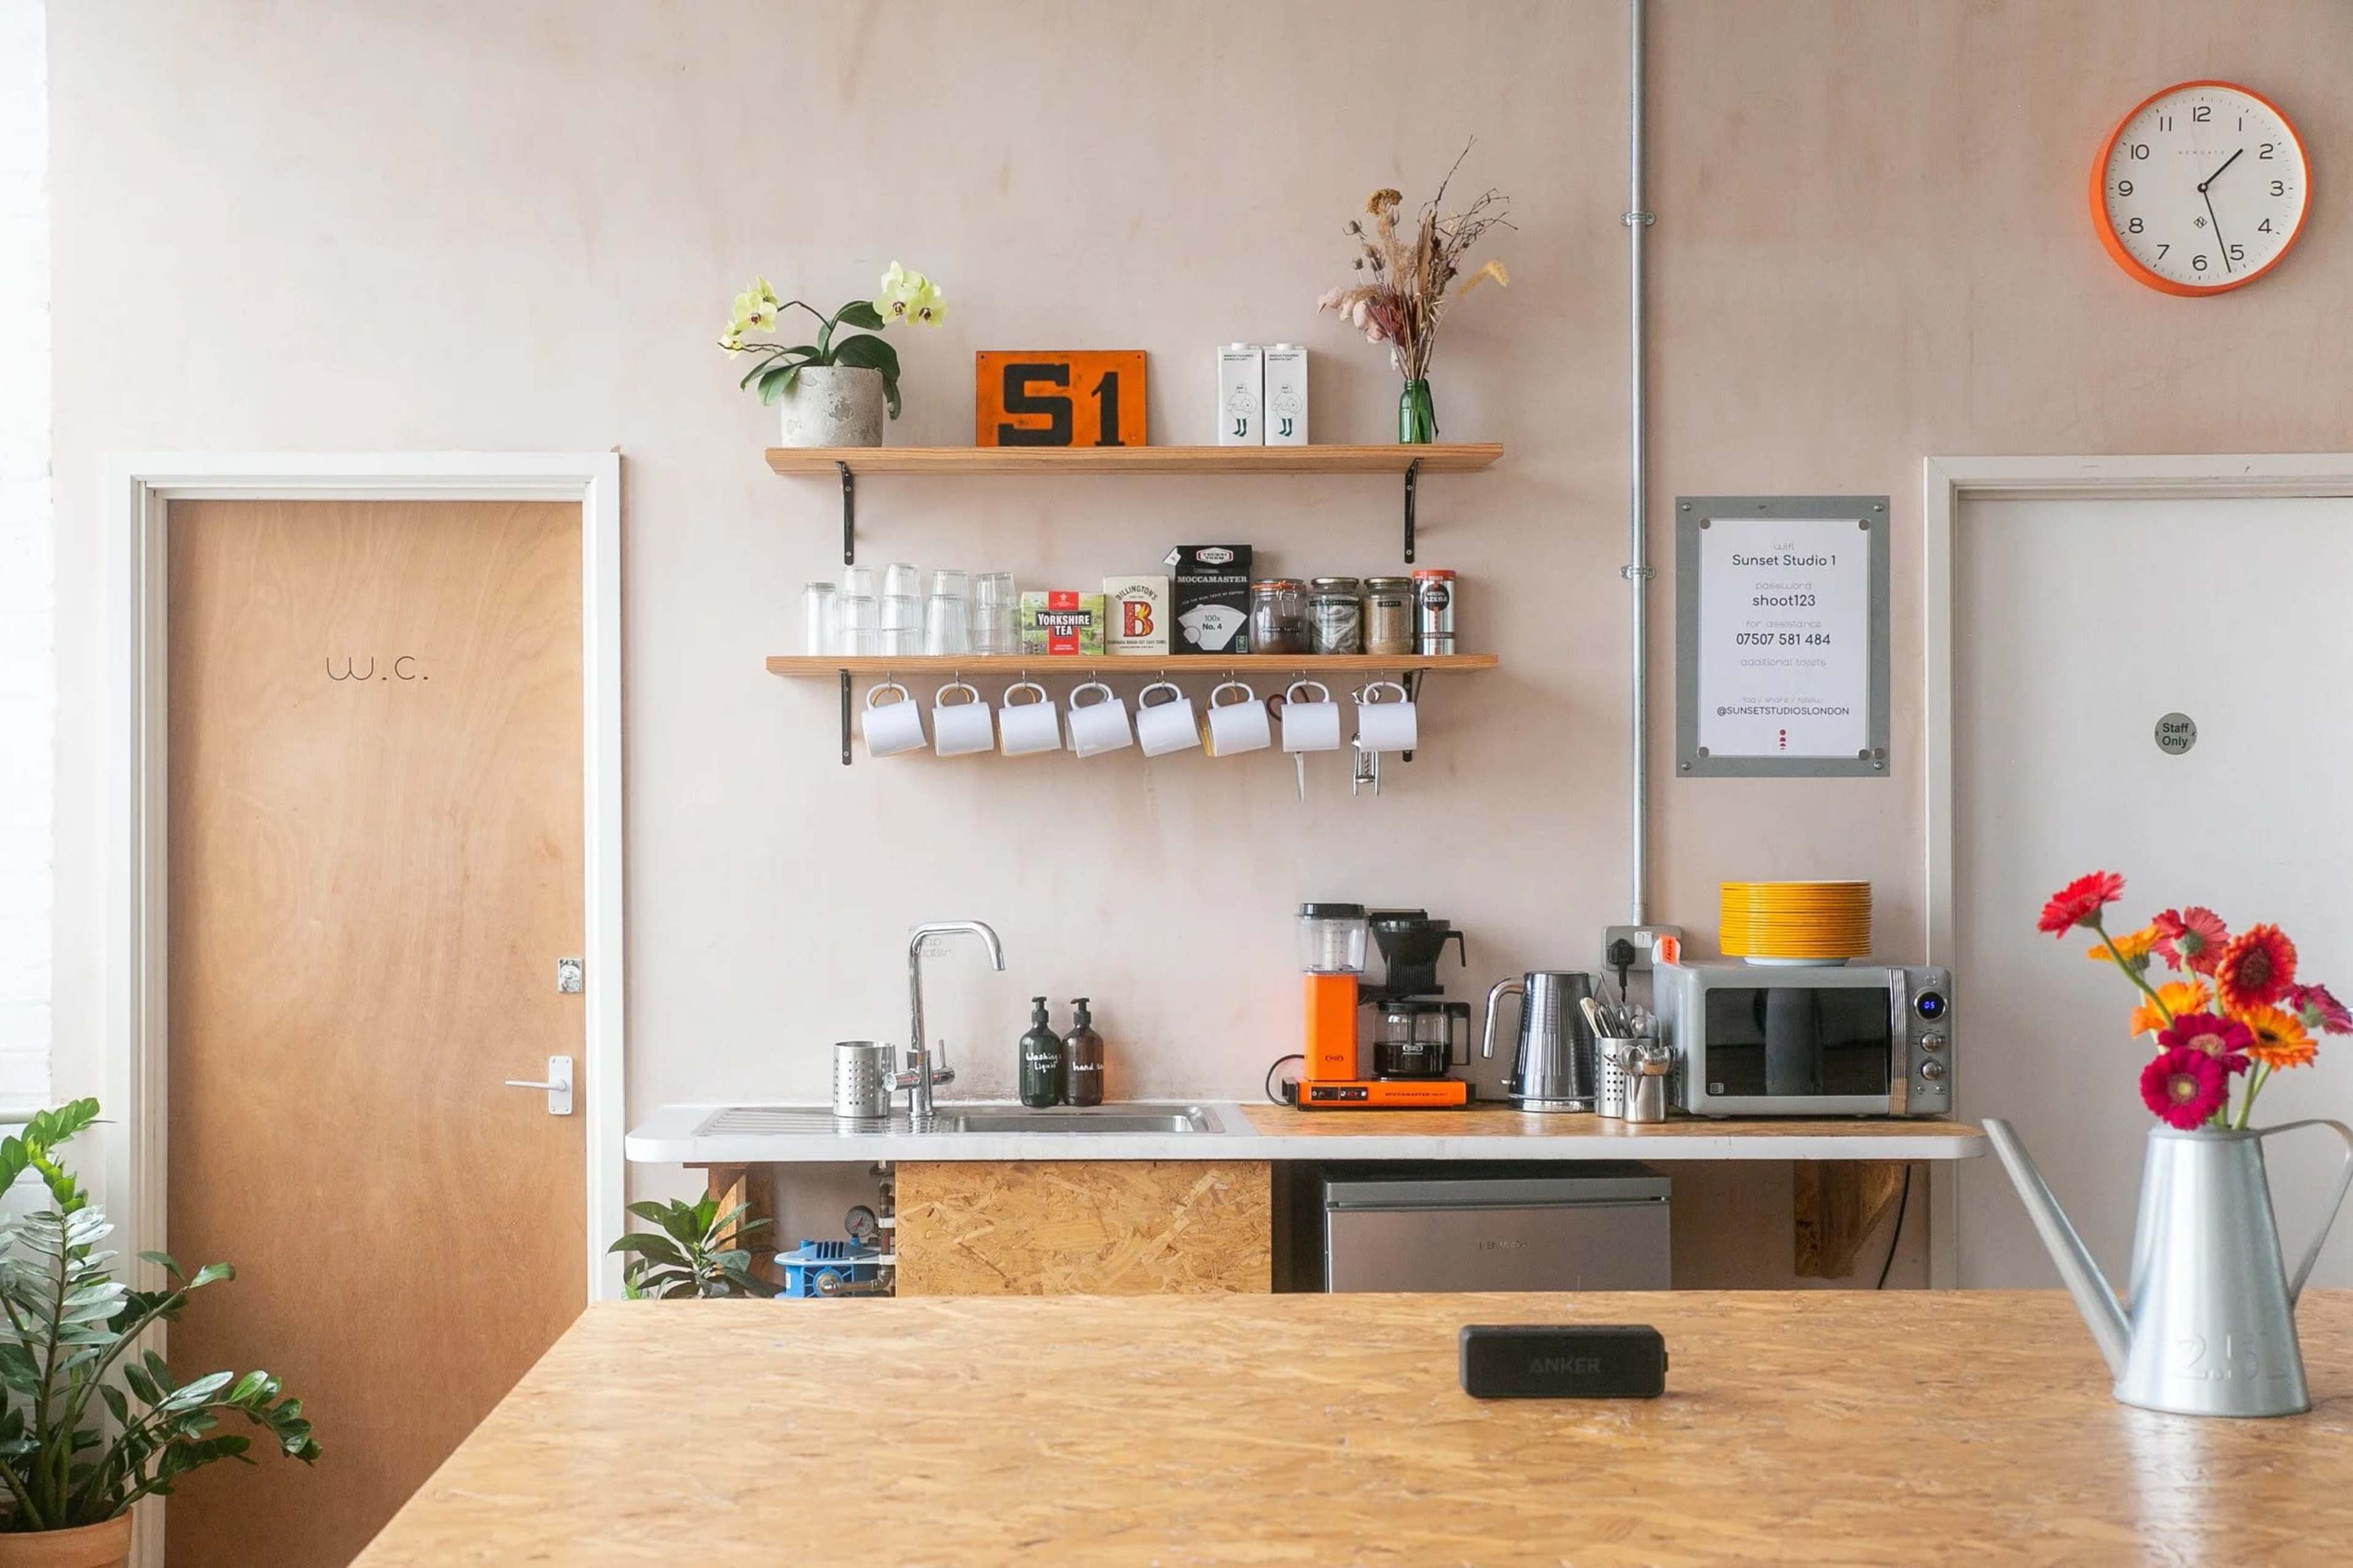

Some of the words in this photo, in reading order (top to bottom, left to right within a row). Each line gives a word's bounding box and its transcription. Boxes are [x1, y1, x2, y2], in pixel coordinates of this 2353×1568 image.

[2192, 106, 2211, 122] 12
[2159, 116, 2172, 132] 11
[2238, 116, 2243, 132] 1
[2130, 144, 2150, 160] 10
[2259, 143, 2274, 160] 2
[2118, 180, 2134, 197] 9
[2269, 180, 2285, 197] 3
[2128, 217, 2144, 234] 8
[2257, 218, 2273, 234] 4
[2156, 244, 2170, 260] 7
[2230, 244, 2245, 260] 5
[2192, 254, 2208, 271] 6
[1732, 554, 1779, 566] Sunset
[1783, 554, 1827, 566] Studio
[1831, 555, 1836, 566] 1
[1115, 585, 1158, 602] BILLINGTON'S
[1755, 581, 1813, 591] password
[1752, 594, 1816, 607] shoot123
[1038, 613, 1090, 625] YORKSHIRE
[1123, 600, 1154, 637] B
[1746, 619, 1762, 628] for
[1766, 619, 1822, 628] assistance
[1055, 626, 1072, 635] TEA
[1736, 633, 1775, 645] 07507
[1779, 633, 1800, 645] 581
[1805, 633, 1831, 645] 484
[1717, 706, 1849, 716] @SUNSETSTUDIOSLONDON
[2162, 722, 2189, 733] Staff
[2162, 735, 2188, 749] Only
[1072, 1061, 1094, 1072] hand
[1529, 1357, 1601, 1375] ANKER
